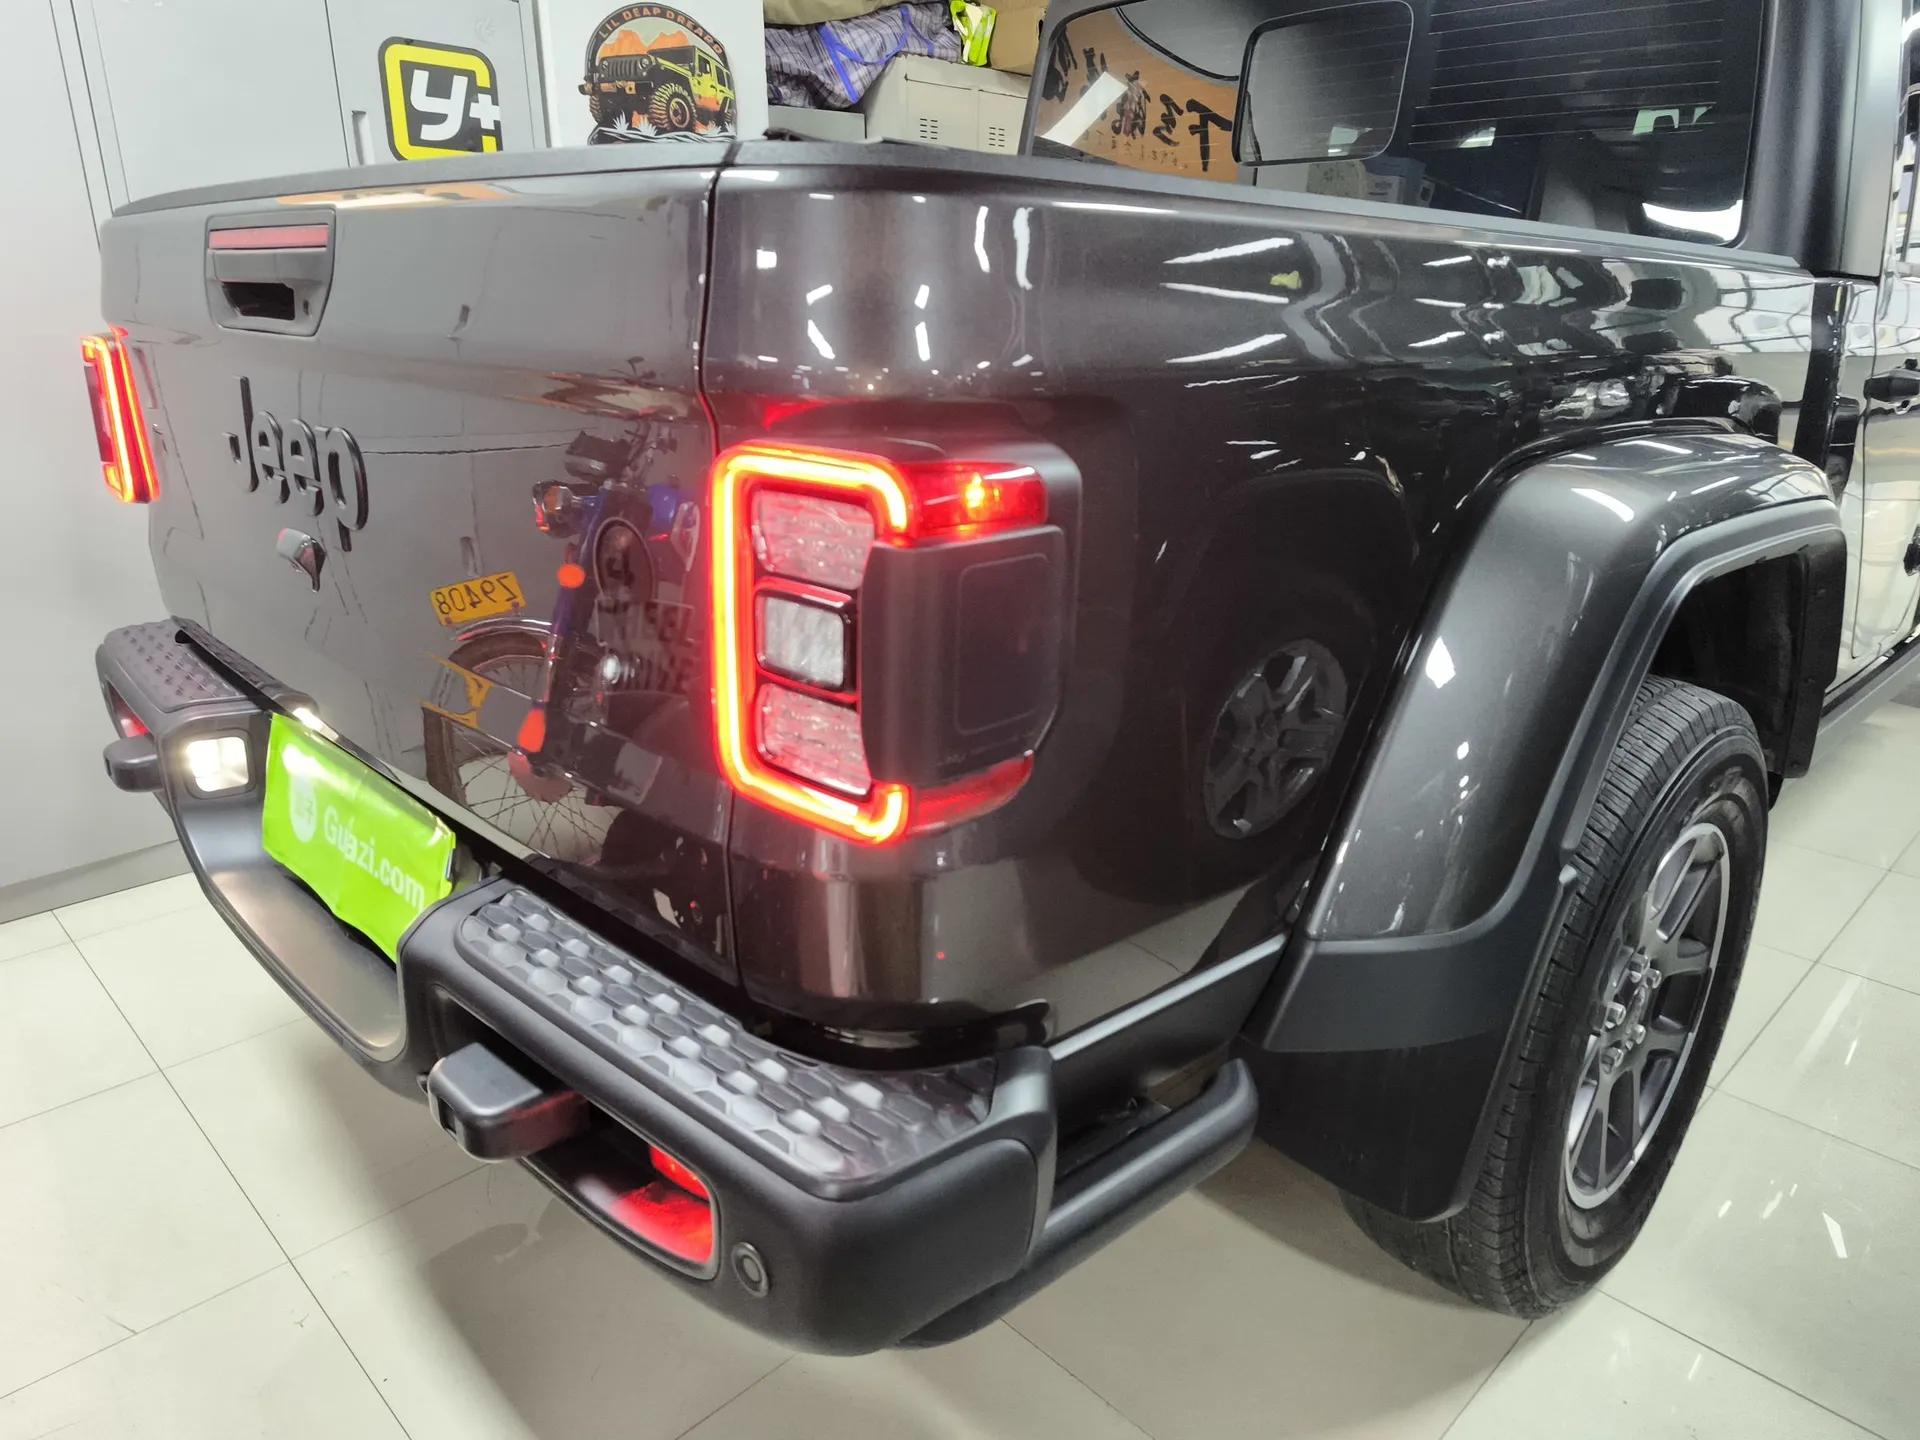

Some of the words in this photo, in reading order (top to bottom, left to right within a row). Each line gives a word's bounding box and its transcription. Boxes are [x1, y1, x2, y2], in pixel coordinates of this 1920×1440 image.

[598, 19, 620, 39] LIL
[222, 376, 369, 552] Jeep
[324, 804, 425, 914] Guazi.com
